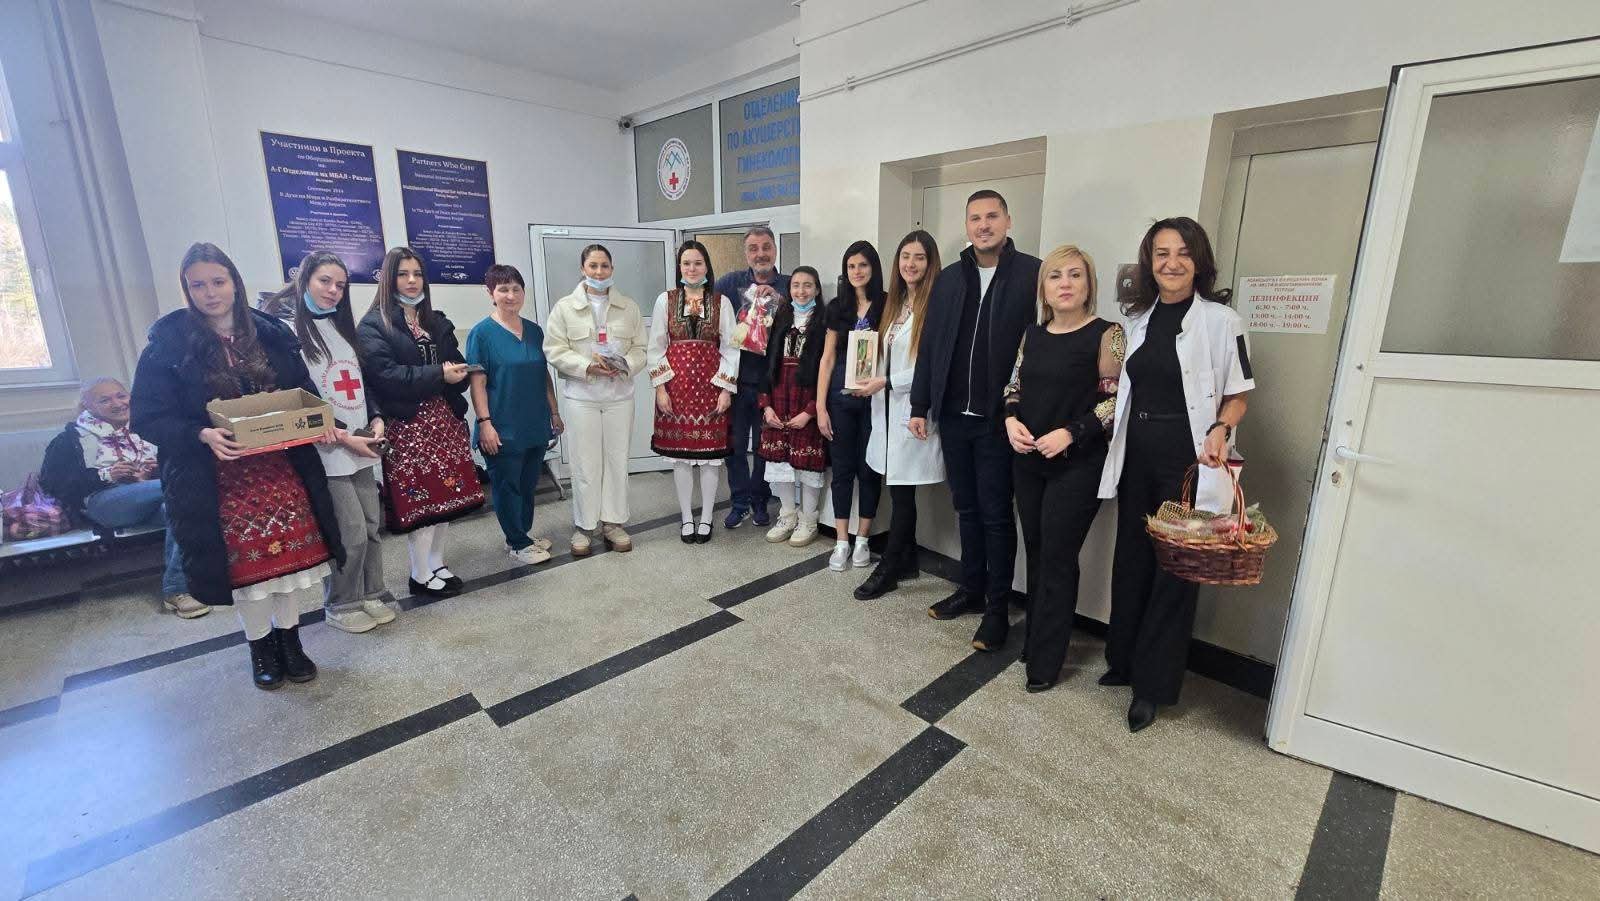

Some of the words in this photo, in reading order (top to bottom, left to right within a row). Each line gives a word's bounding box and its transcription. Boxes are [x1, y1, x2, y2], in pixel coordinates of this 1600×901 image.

[270, 138, 320, 152] Участници
[330, 146, 366, 158] Проекта
[412, 157, 442, 167] Partners
[442, 160, 458, 168] Who
